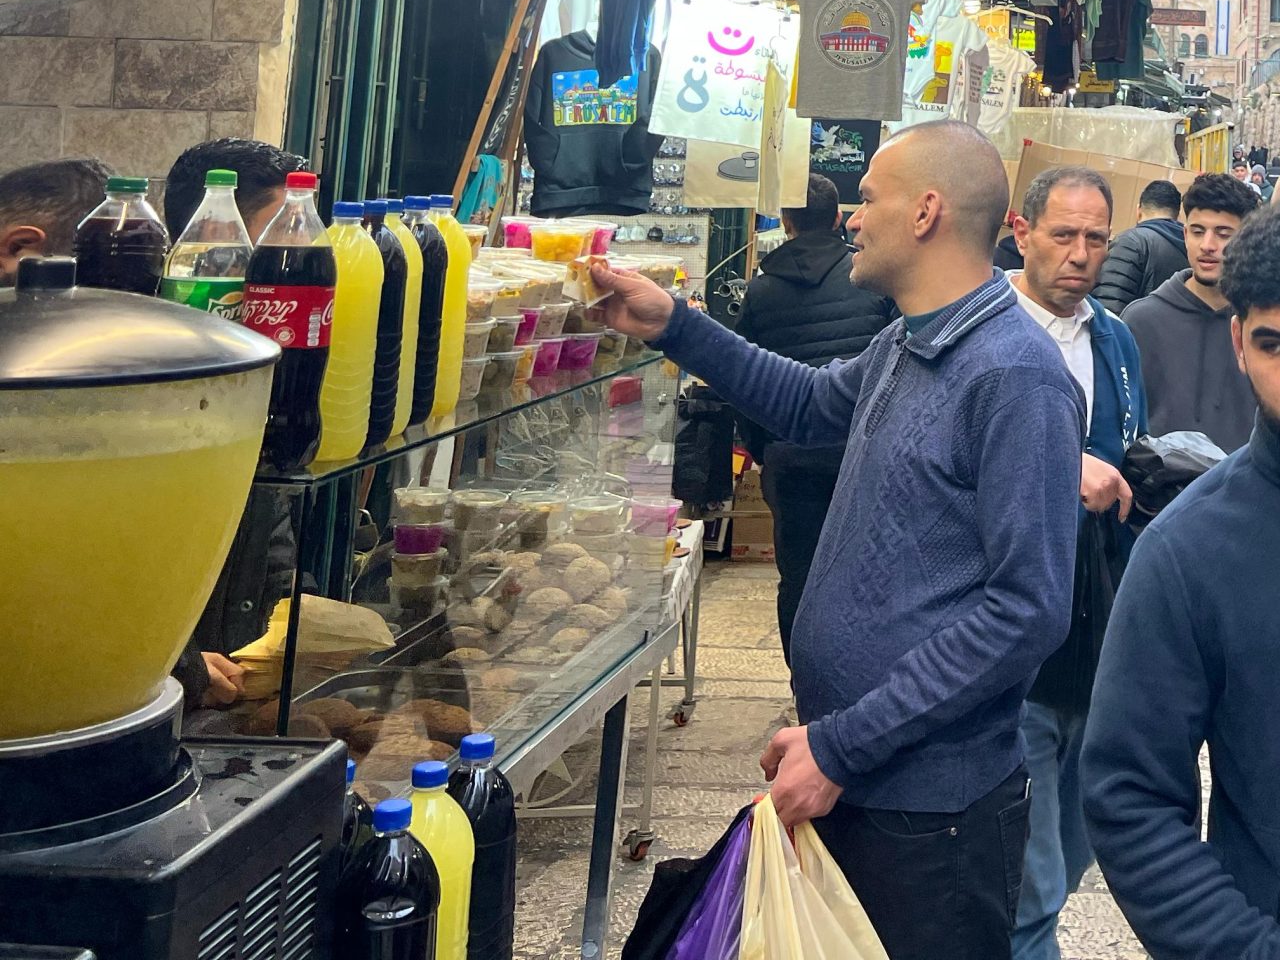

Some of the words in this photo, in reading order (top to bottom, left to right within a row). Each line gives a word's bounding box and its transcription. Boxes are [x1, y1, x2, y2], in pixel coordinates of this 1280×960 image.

[835, 54, 874, 65] JERUSALEM
[714, 59, 766, 85] بسوطة
[914, 103, 945, 112] SALEM
[556, 103, 635, 124] JERUSALEM
[249, 286, 275, 294] CLASSIC
